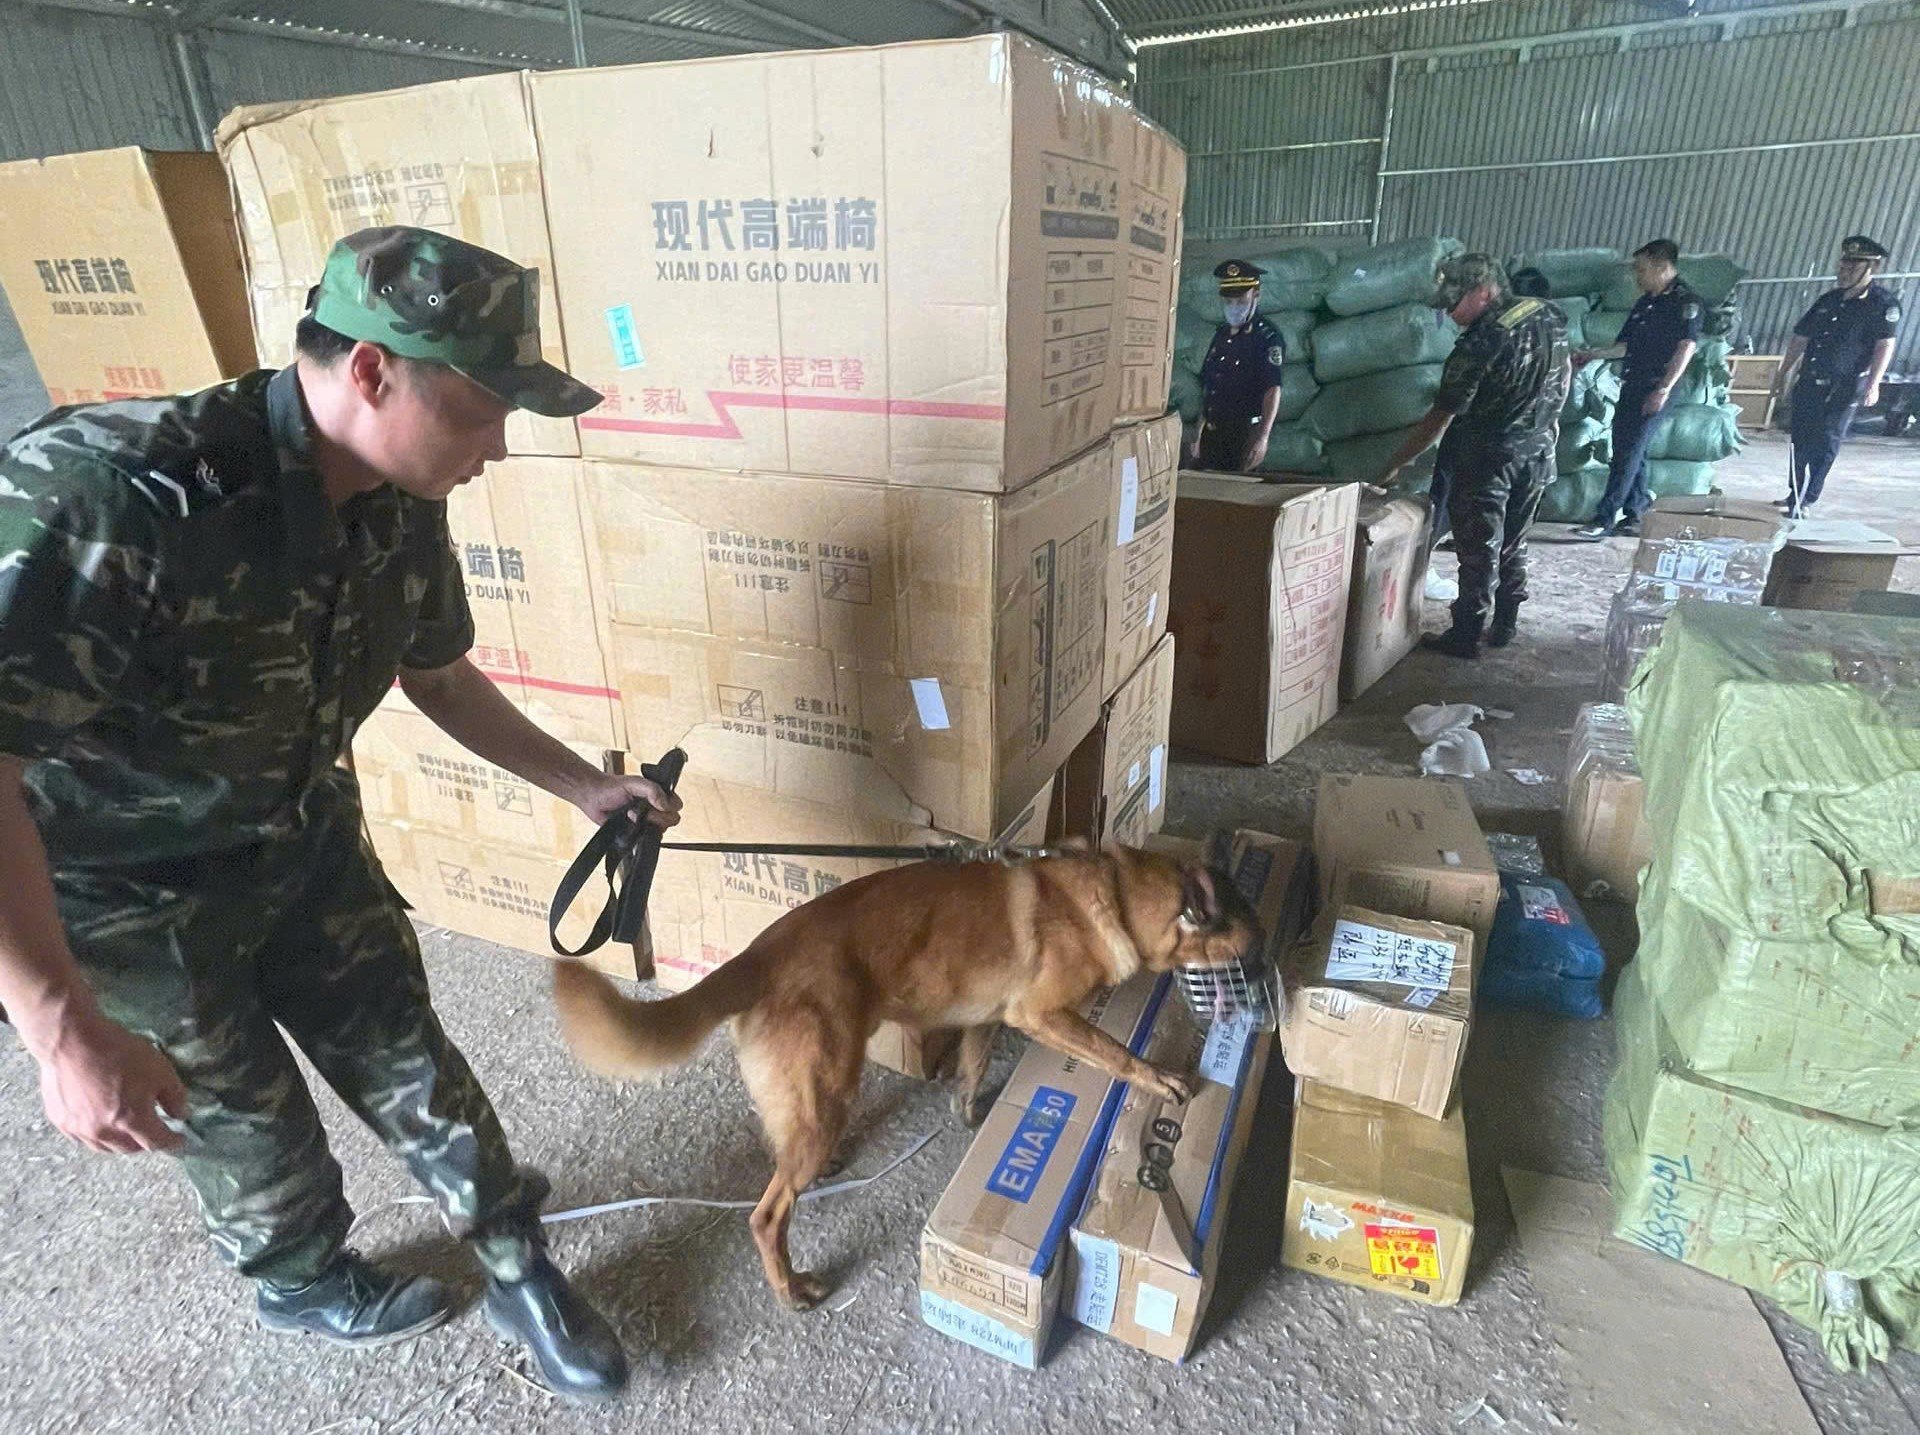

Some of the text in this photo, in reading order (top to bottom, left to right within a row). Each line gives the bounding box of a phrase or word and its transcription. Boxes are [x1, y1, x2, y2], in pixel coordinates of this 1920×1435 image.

[651, 197, 877, 251] 现代高端椅
[656, 261, 879, 283] XIAN DAI GAO DUAN YI
[728, 354, 865, 391] 使家更温馨
[476, 584, 513, 602] DUAN
[517, 588, 530, 604] YI
[723, 874, 756, 896] XIAN
[759, 886, 783, 906] DAI
